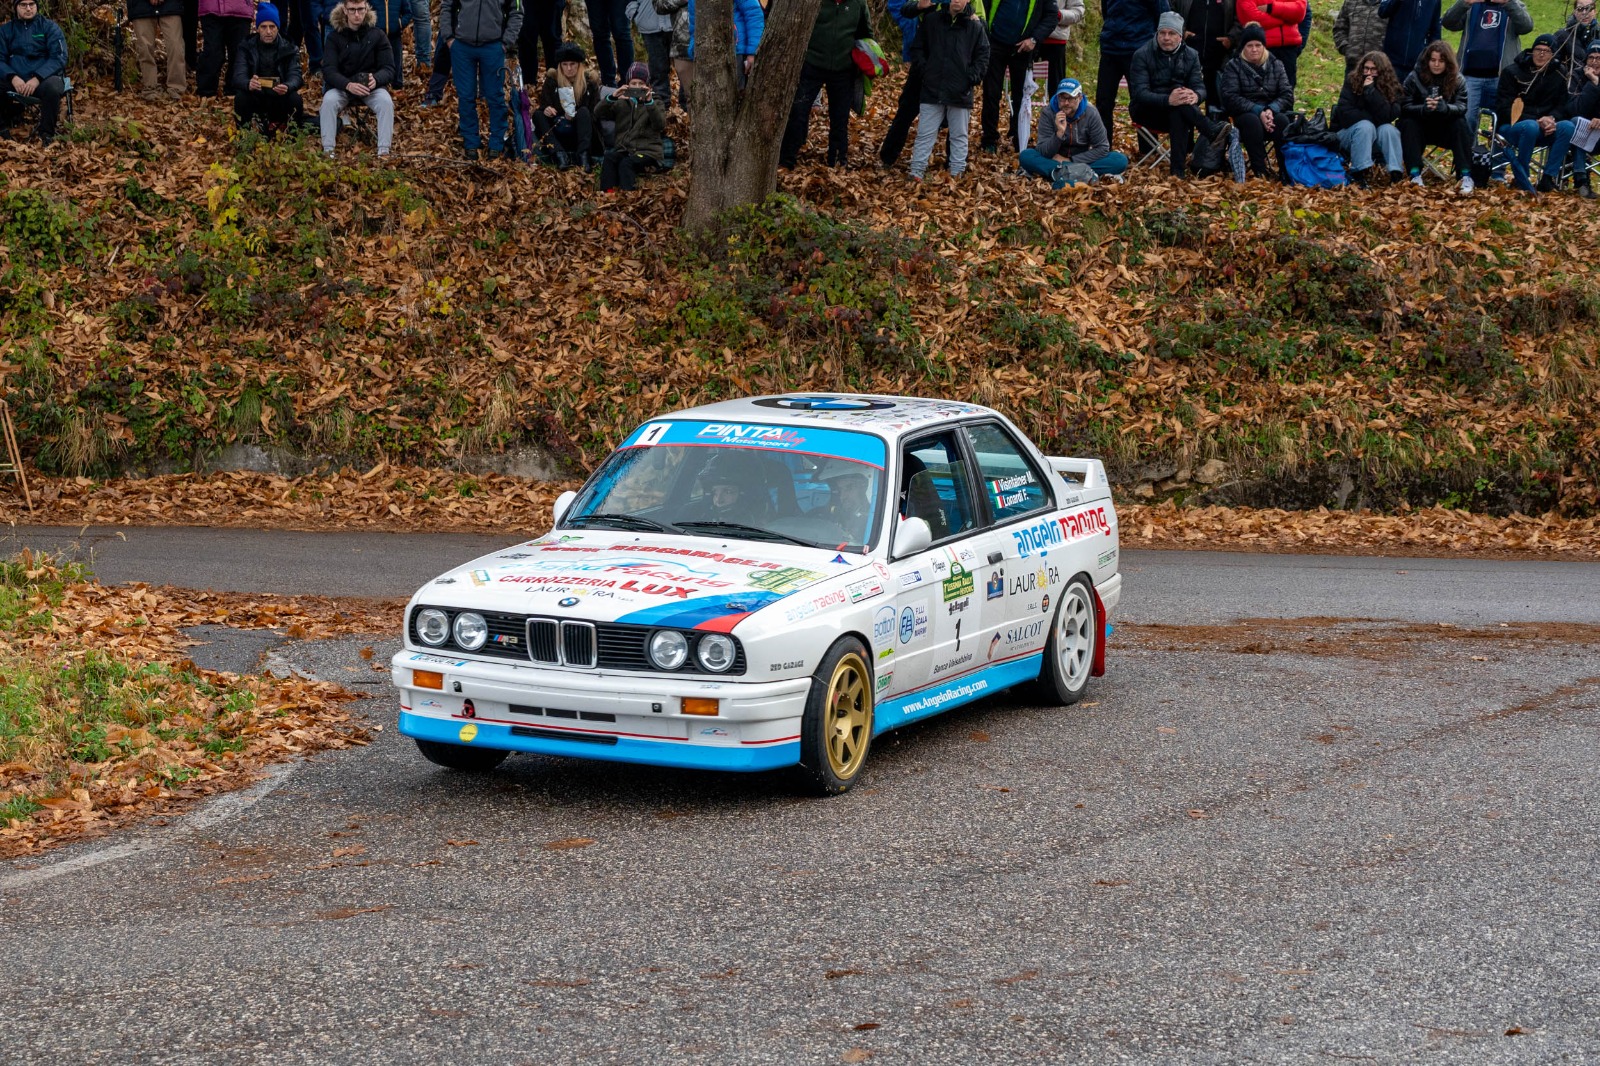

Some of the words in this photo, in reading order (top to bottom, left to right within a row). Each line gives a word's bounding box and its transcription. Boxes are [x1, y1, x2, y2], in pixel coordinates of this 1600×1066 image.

[647, 426, 663, 442] 1
[697, 423, 784, 439] PINTA
[720, 436, 792, 448] Motorsport
[498, 575, 617, 588] CARROZZERIA
[618, 580, 699, 599] LUX
[813, 590, 847, 610] racing
[955, 618, 961, 652] 1
[1006, 620, 1045, 645] SALCOT
